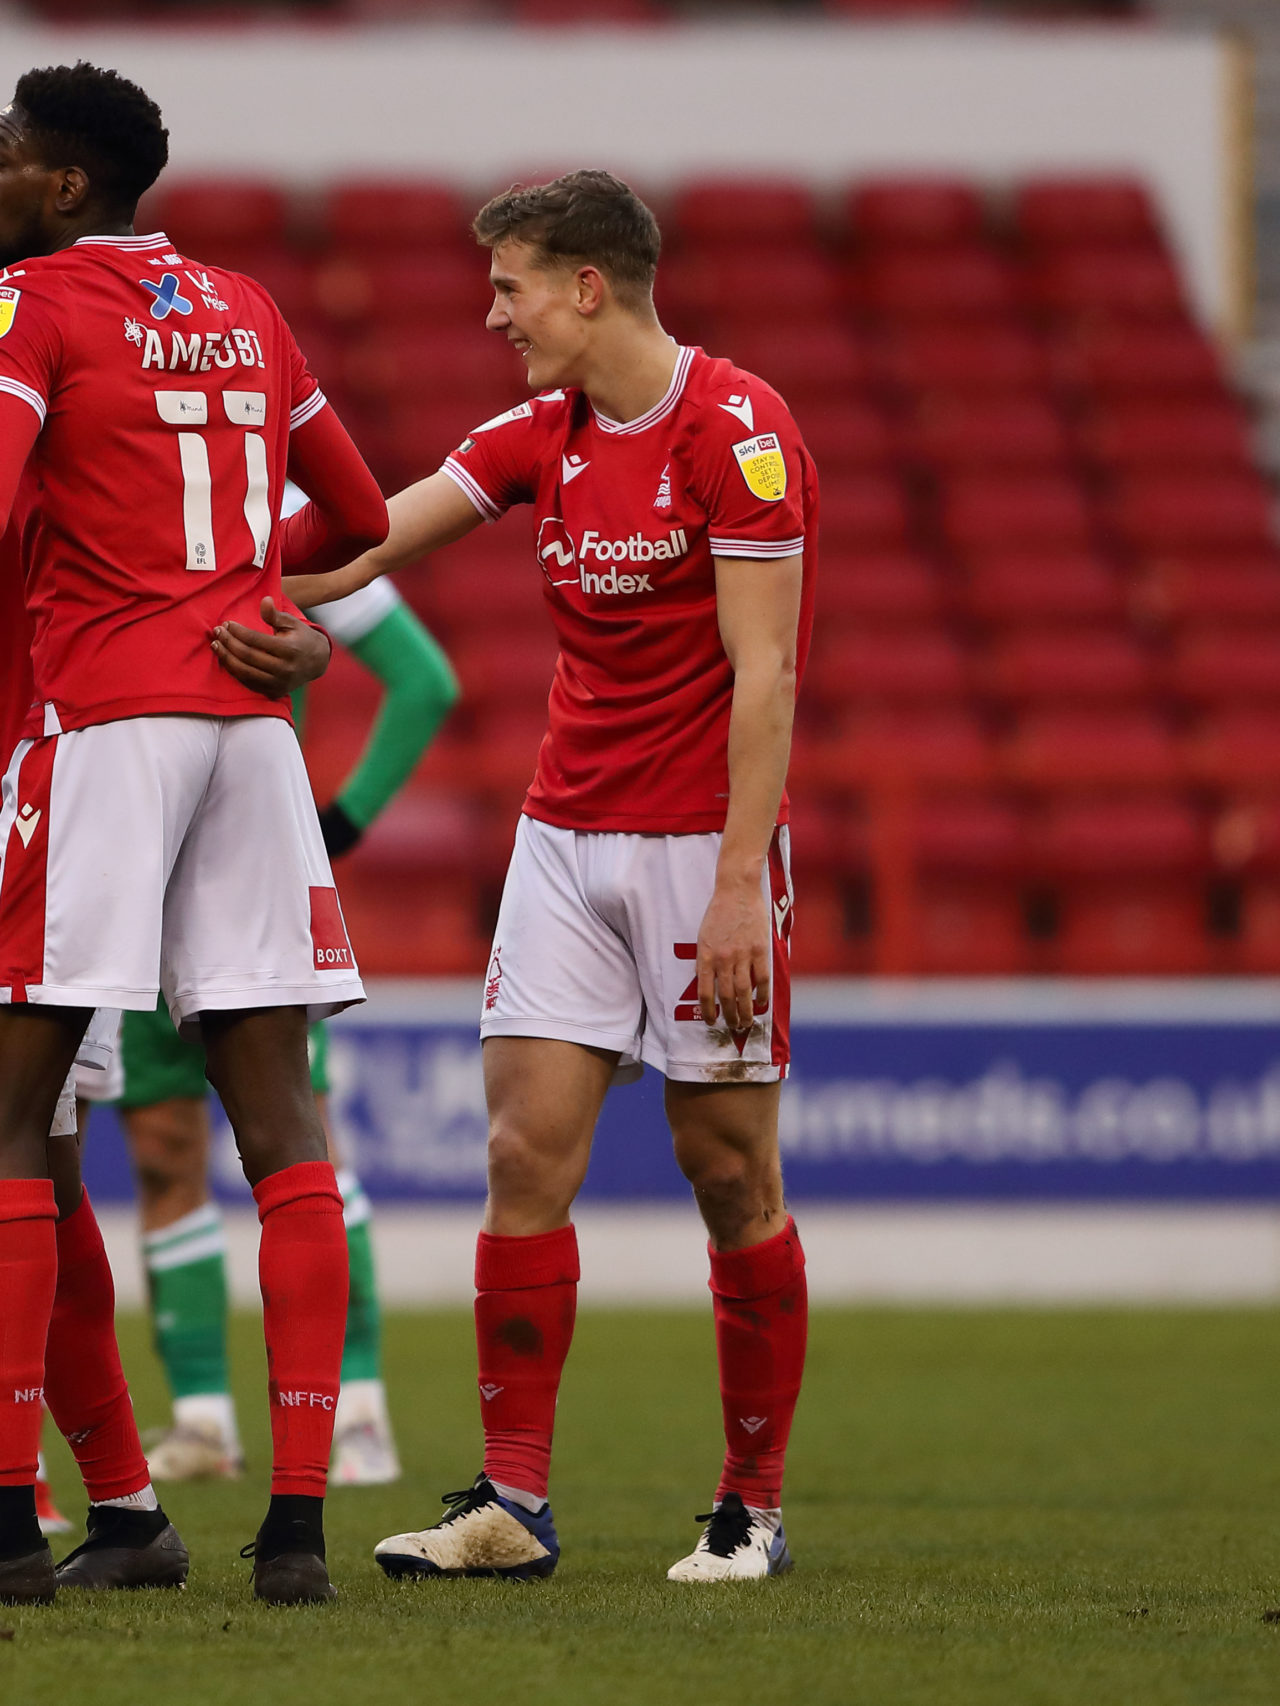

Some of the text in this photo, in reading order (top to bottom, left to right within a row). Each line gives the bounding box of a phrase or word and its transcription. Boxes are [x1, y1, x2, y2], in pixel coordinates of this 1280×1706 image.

[141, 328, 266, 372] AMEOBI
[739, 438, 775, 456] sky bet
[752, 456, 768, 466] STAY
[154, 390, 272, 571] 11
[578, 528, 689, 562] Football
[196, 557, 207, 565] EFL
[579, 564, 655, 595] Index
[316, 948, 349, 964] BOXT
[278, 1390, 335, 1411] NFFC
